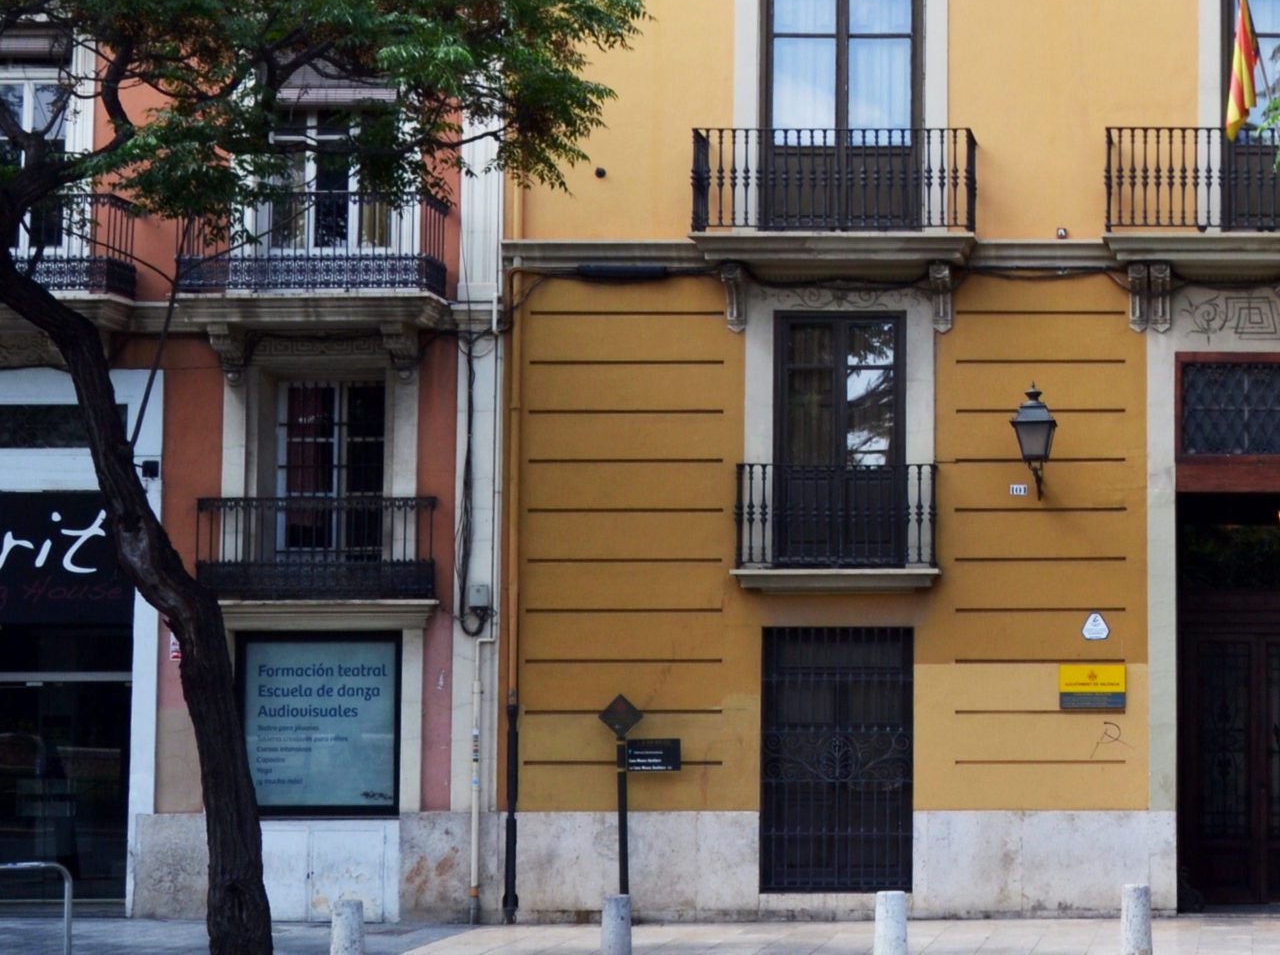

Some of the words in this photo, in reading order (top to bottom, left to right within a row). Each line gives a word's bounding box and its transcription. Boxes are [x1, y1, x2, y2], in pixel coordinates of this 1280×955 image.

[258, 663, 334, 678] Formación
[338, 663, 387, 678] teatral
[258, 685, 313, 698] Escuela
[316, 685, 334, 698] de
[337, 685, 381, 702] danza
[257, 705, 359, 718] Audiovisuales
